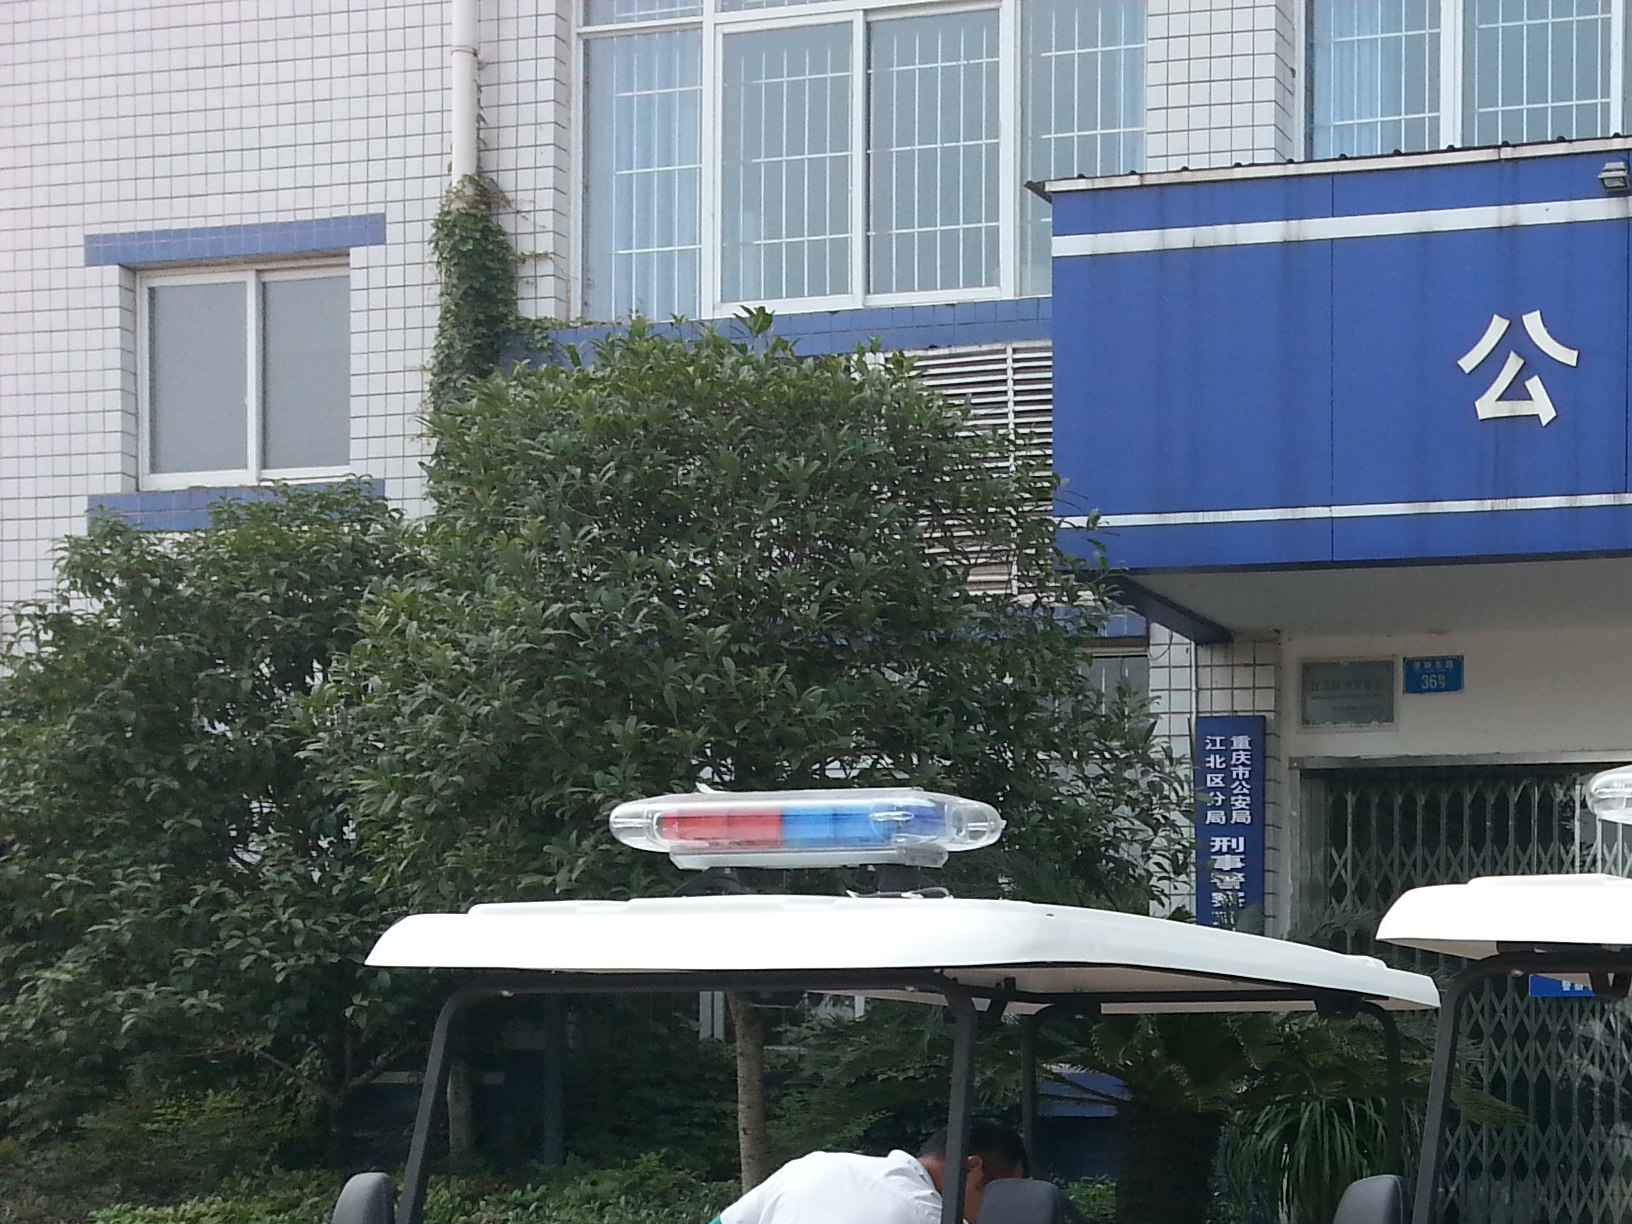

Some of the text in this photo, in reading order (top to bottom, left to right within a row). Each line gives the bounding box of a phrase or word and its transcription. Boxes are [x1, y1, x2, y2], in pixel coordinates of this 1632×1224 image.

[1205, 735, 1227, 825] 江北区分局
[1230, 735, 1252, 825] 重庆市公安局
